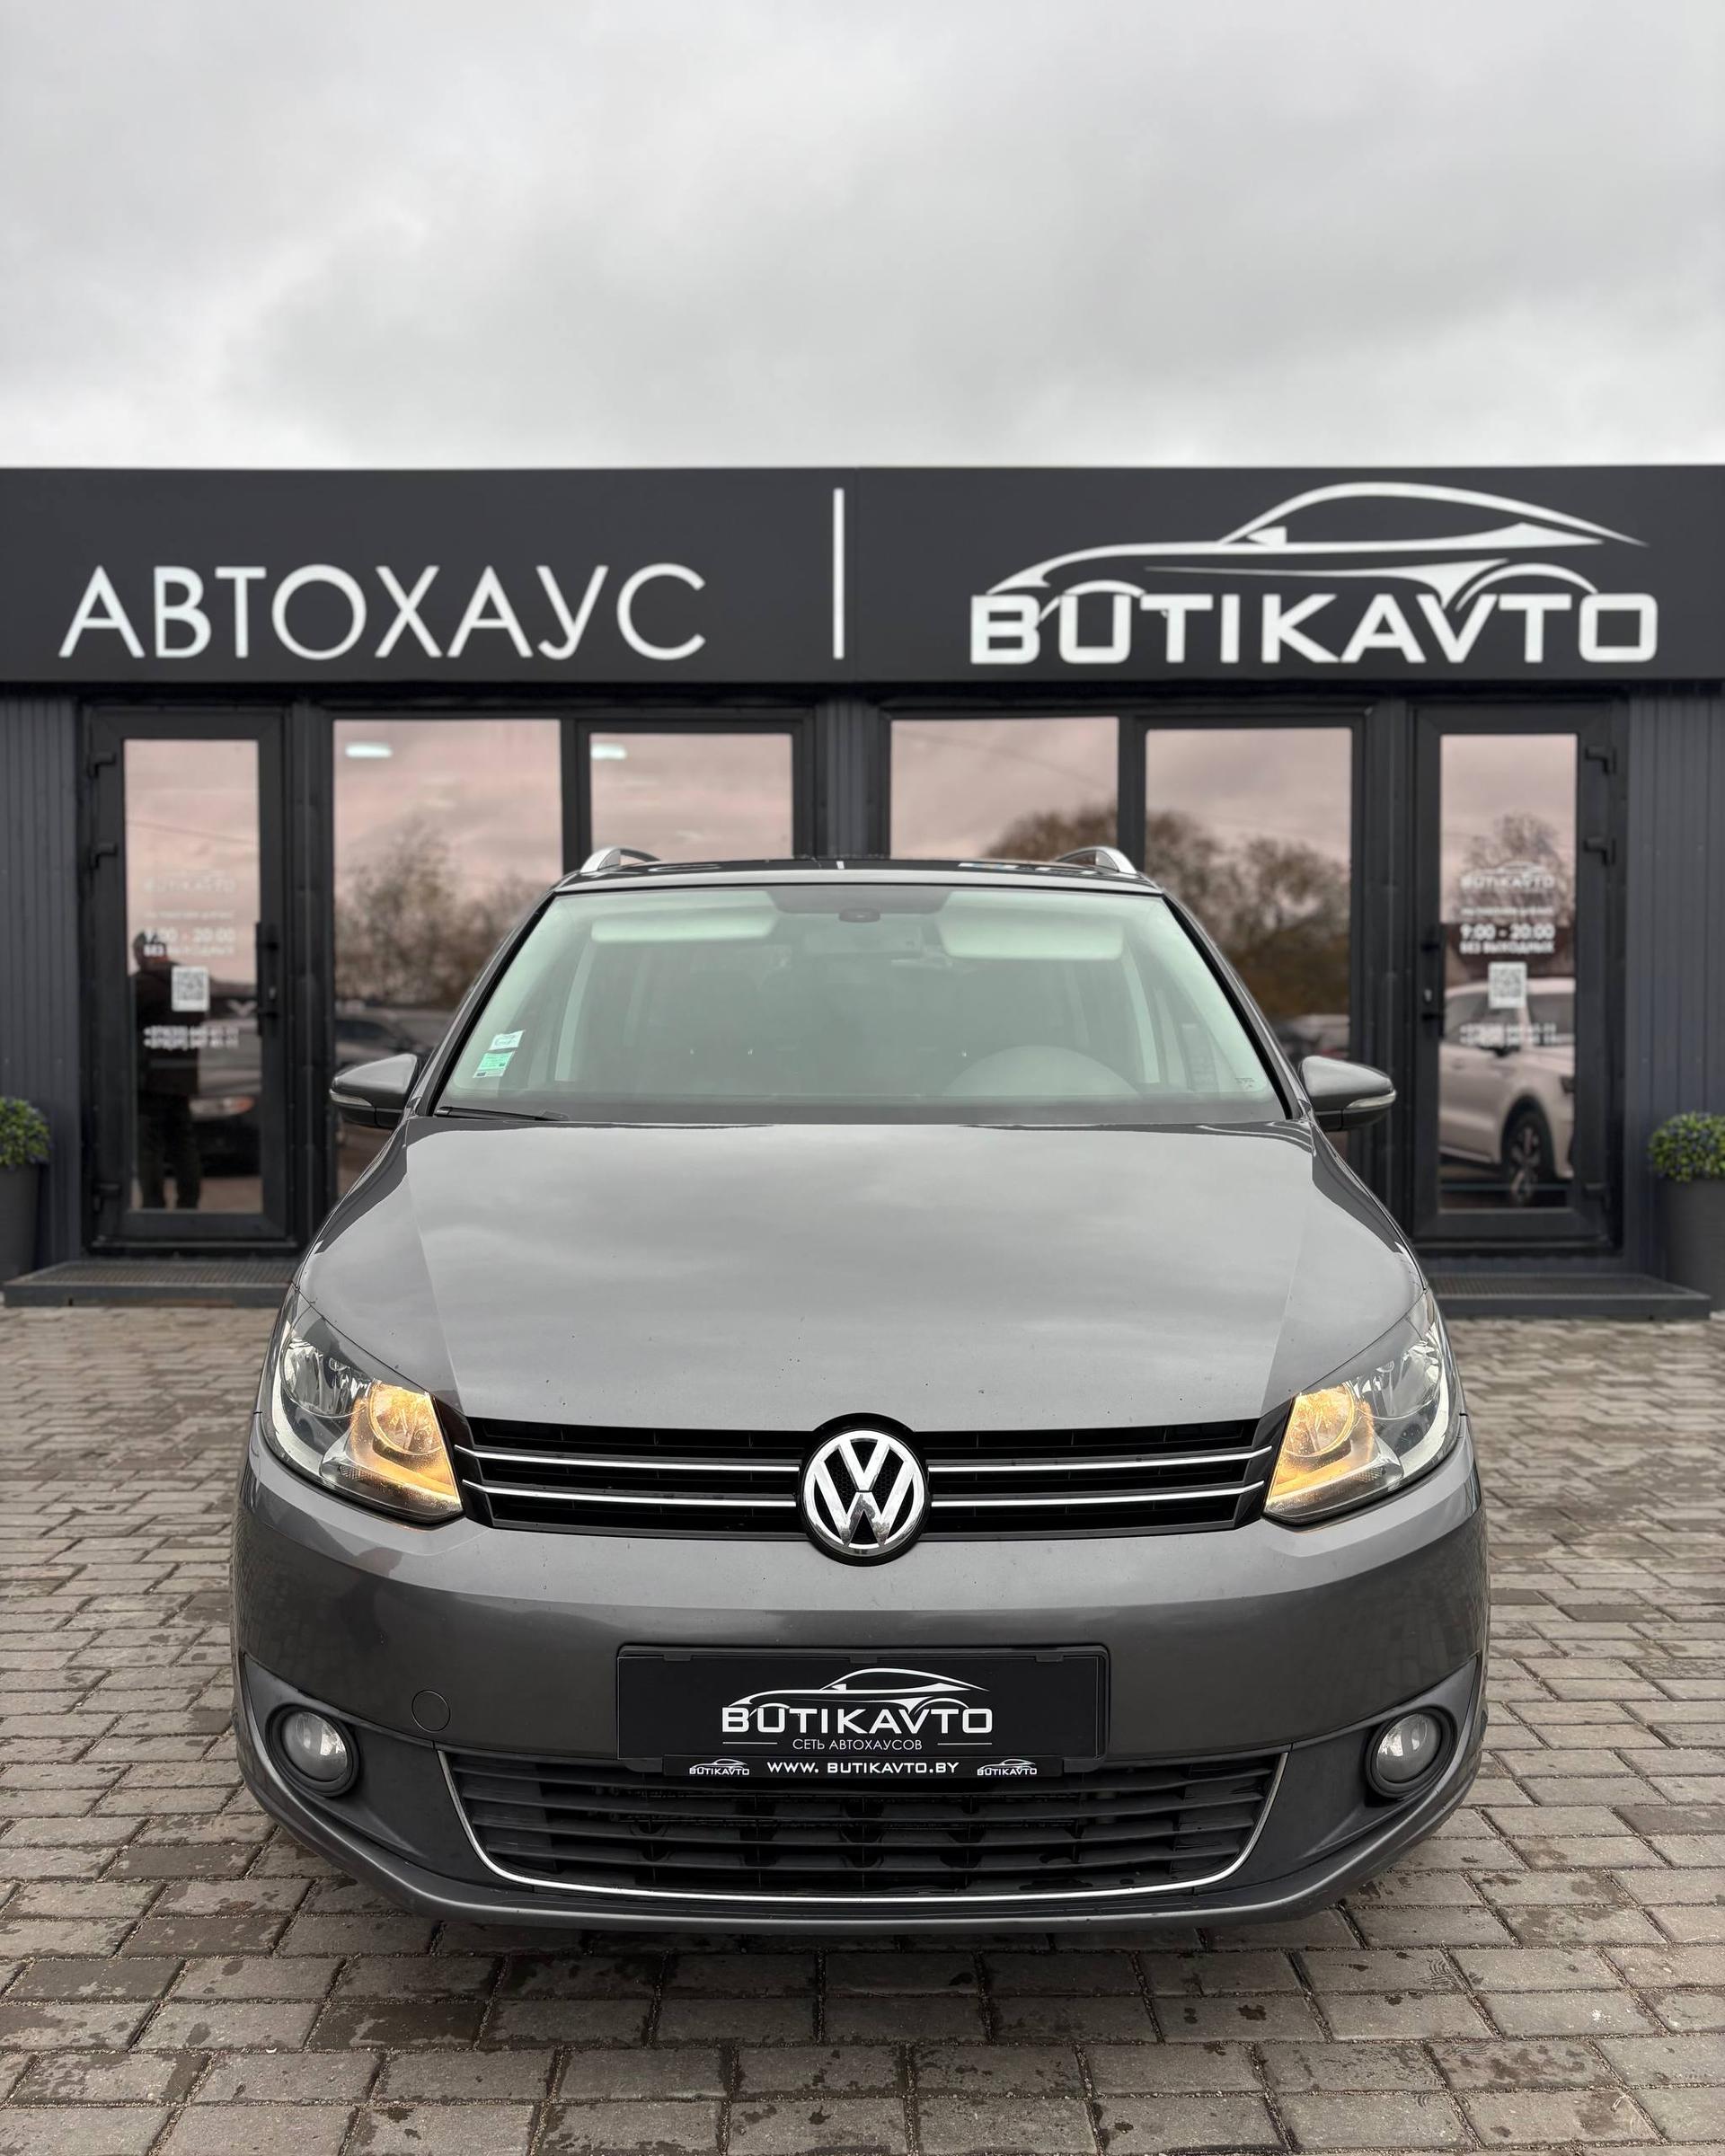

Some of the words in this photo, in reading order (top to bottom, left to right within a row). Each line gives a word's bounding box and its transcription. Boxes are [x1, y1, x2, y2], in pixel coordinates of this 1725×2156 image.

[58, 563, 706, 661] АВТОХАУС
[970, 593, 1659, 664] BUTIKAVTO
[805, 1430, 924, 1552] VW
[721, 1707, 994, 1735] BUTIKAVTO
[792, 1738, 825, 1751] СЕТЬ
[828, 1738, 923, 1752] АВТОХАУСОВ
[689, 1766, 750, 1776] BUTIKAVTO
[977, 1767, 1038, 1776] BUTIKAVTO
